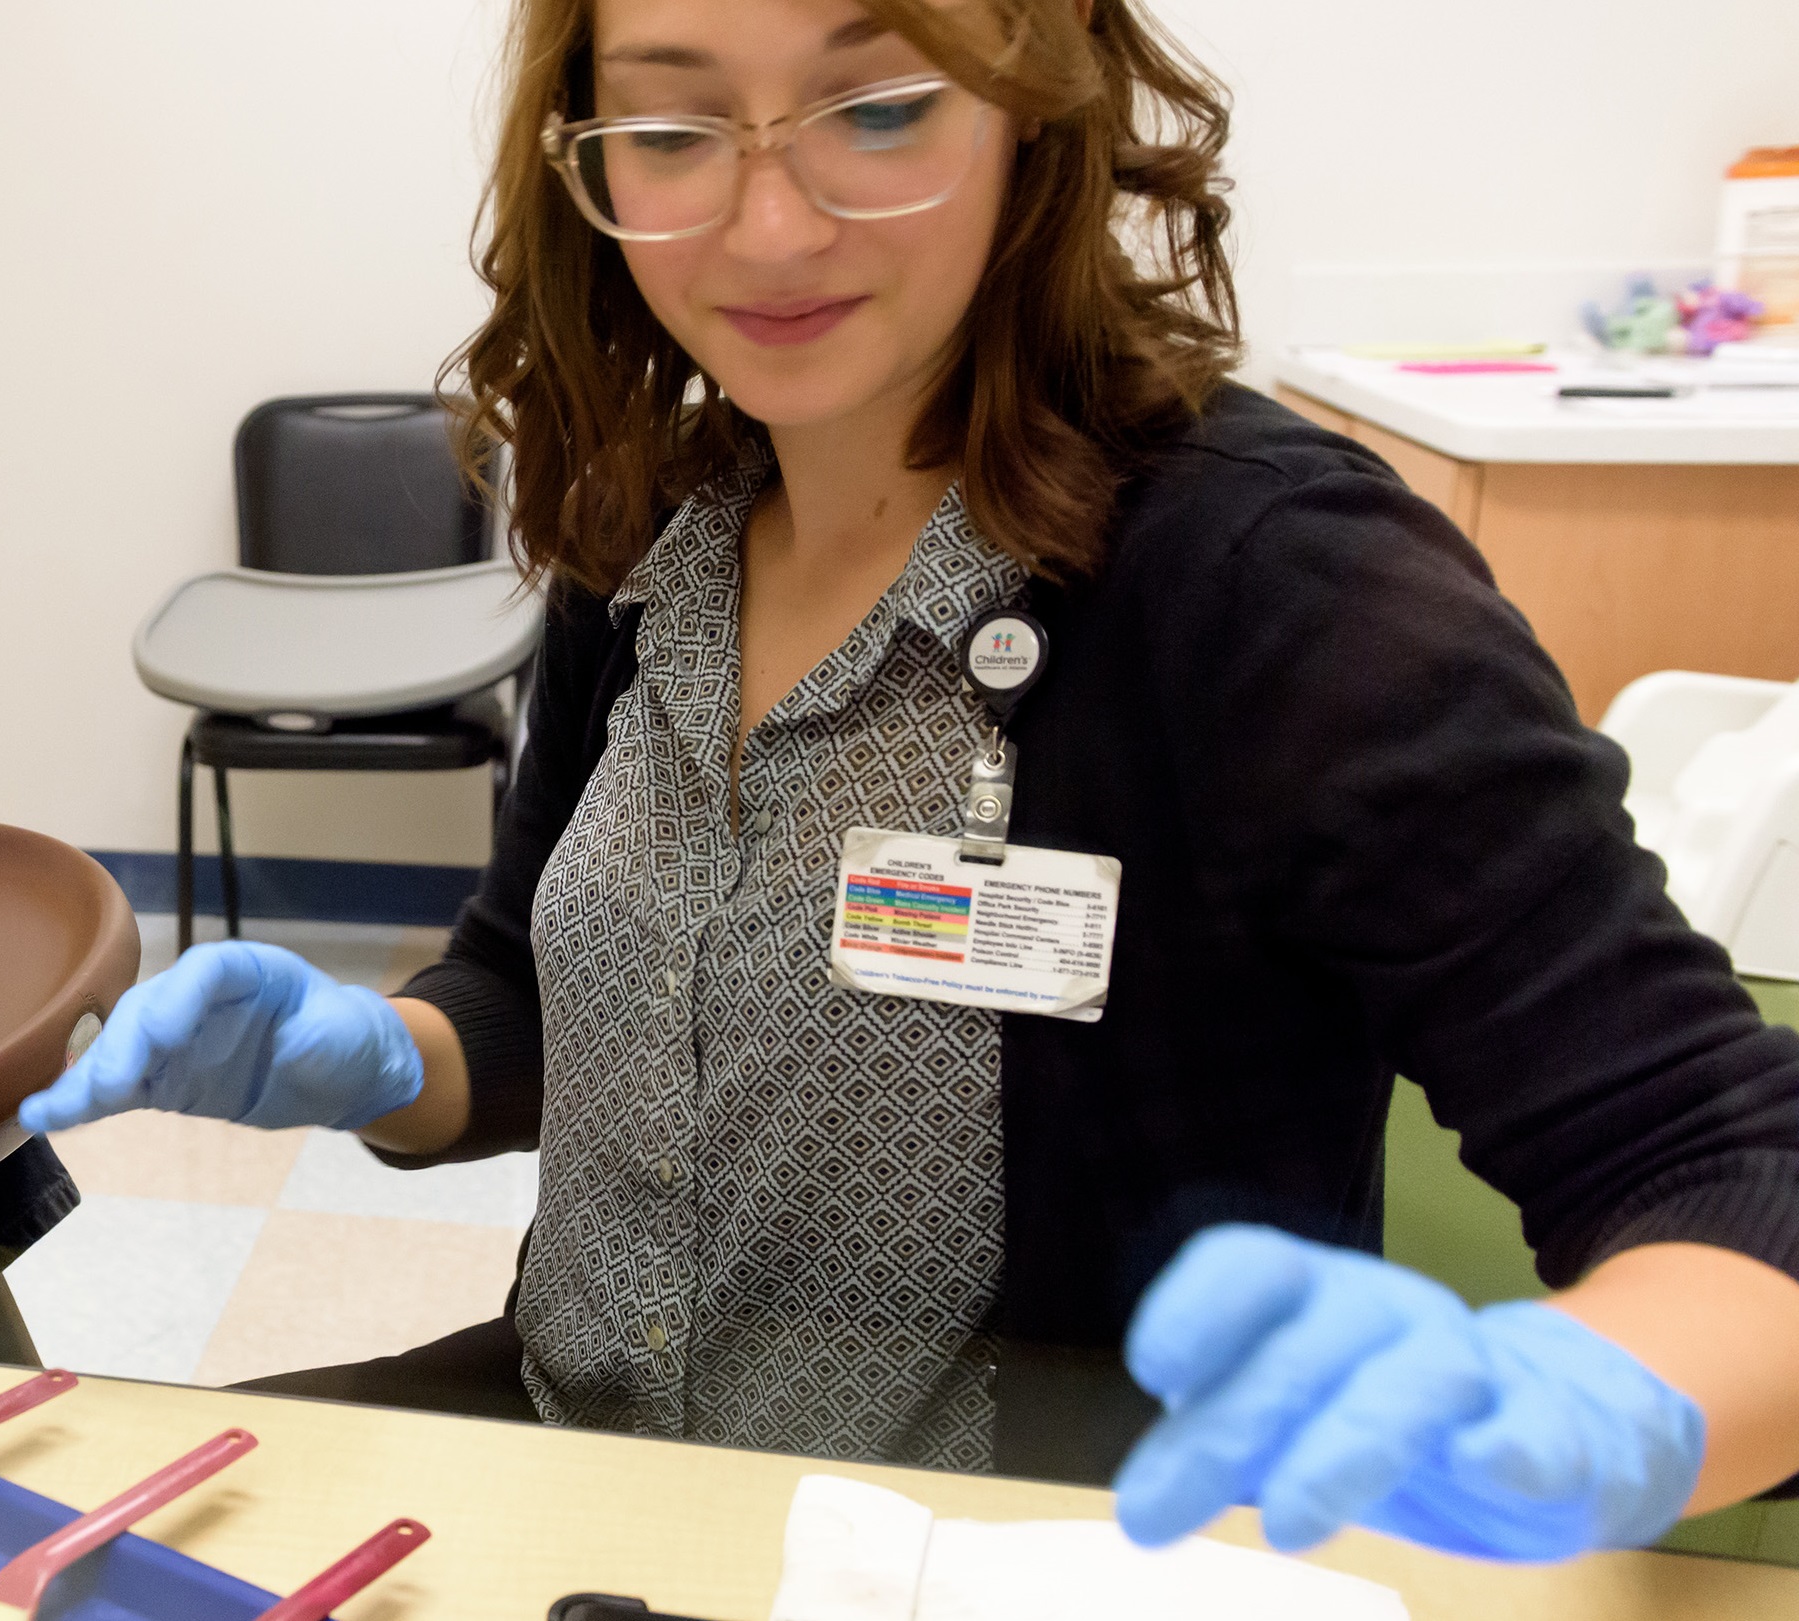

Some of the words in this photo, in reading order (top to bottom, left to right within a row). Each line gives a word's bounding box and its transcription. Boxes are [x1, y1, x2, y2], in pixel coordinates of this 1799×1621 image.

[975, 655, 1028, 665] Children's
[887, 859, 931, 870] CHILDREN'S
[870, 867, 916, 879] EMERGENCY
[919, 873, 944, 881] CODES
[984, 880, 1032, 891] EMERGENCY
[1034, 885, 1061, 895] PHONE
[1064, 890, 1102, 899] NUMBERS
[896, 890, 920, 899] Medical
[921, 892, 956, 904] Emergency
[1006, 895, 1032, 904] Security
[1014, 905, 1039, 913] Security
[977, 910, 1021, 919] Neighborhood
[1023, 915, 1058, 925] Emergency
[913, 920, 932, 928] Threat
[1002, 932, 1034, 940] Command
[913, 940, 937, 948] Weather
[973, 938, 1004, 947] Employee
[996, 950, 1019, 958] Control
[971, 957, 1008, 966] Compliance
[854, 968, 889, 979] Children's
[892, 972, 940, 987] Tobacco-Free
[942, 980, 963, 991] Policy
[996, 988, 1028, 999] enforced
[1029, 992, 1038, 1000] by
